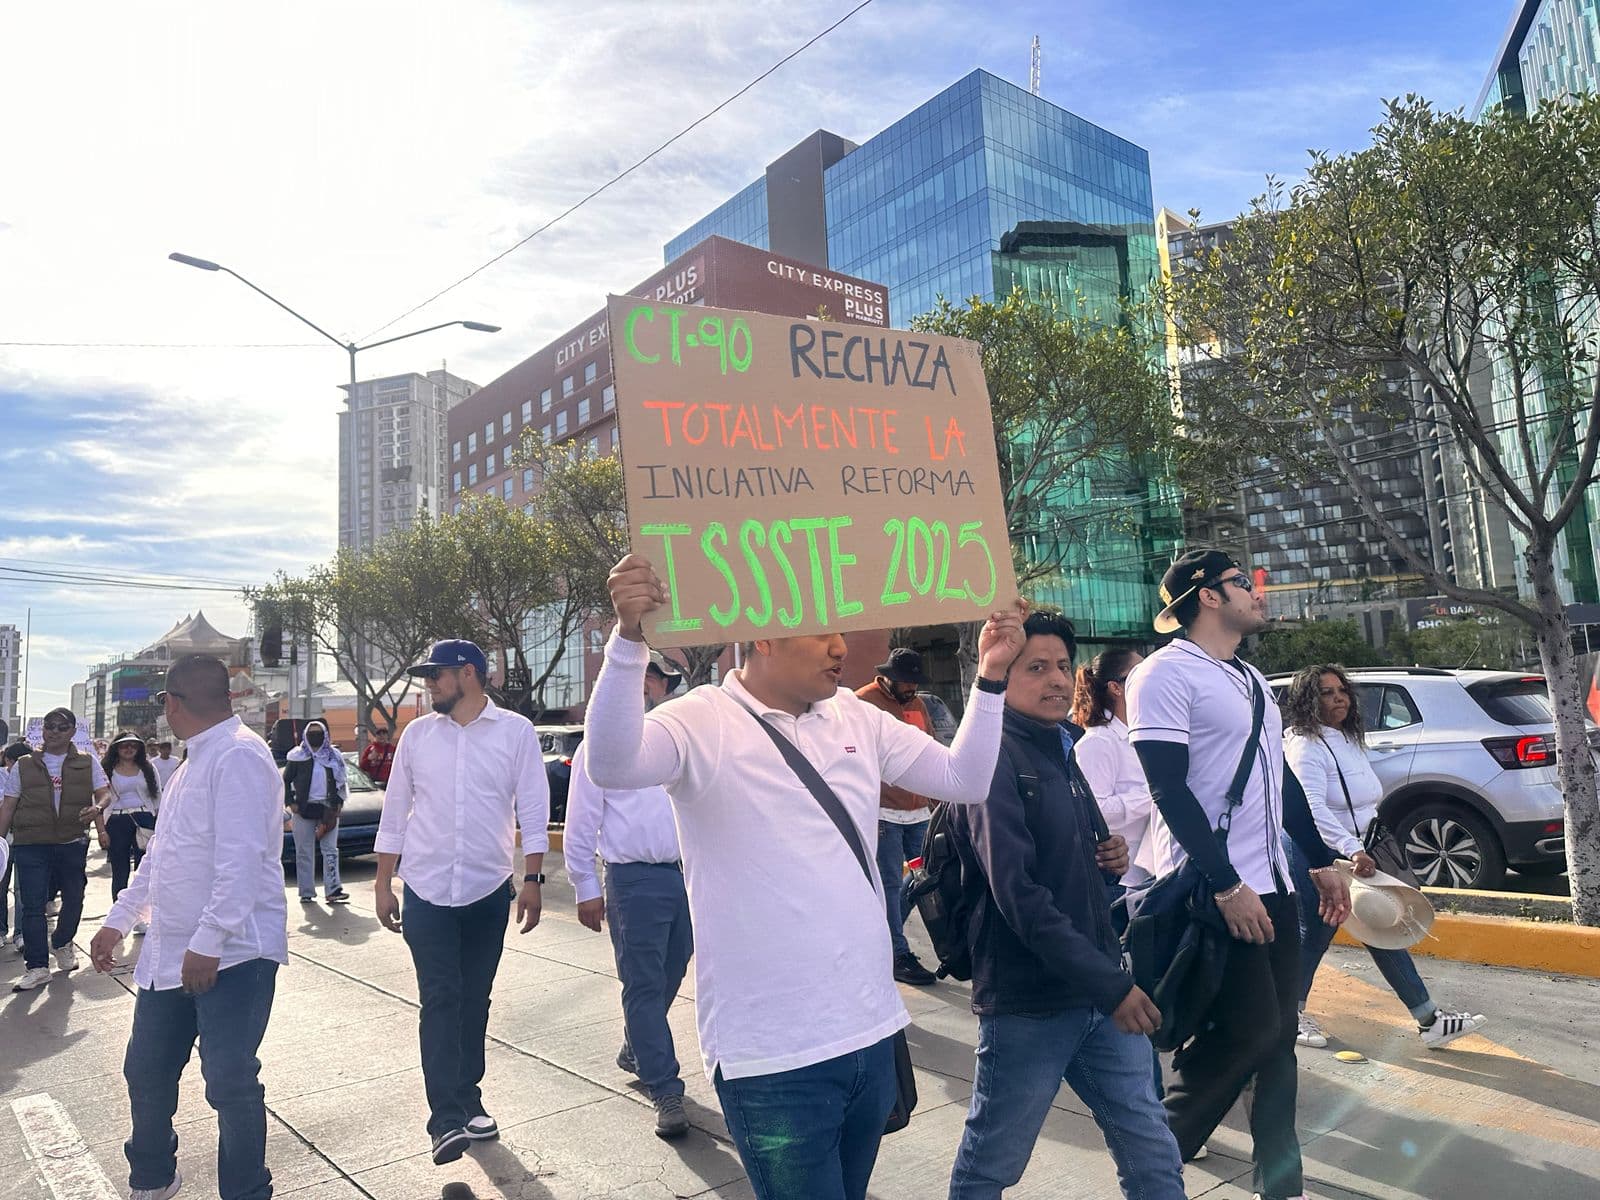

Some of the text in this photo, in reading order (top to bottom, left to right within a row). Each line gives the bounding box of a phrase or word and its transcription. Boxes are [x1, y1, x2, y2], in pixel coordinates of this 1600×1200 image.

[656, 265, 698, 302] PLUS
[767, 260, 883, 305] CITY EXPRESS
[844, 298, 884, 320] PLUS
[556, 336, 585, 366] CITY
[789, 323, 957, 396] RECHAZA
[643, 400, 966, 461] TOTALMENTE LA
[637, 464, 976, 499] INICIATIVA REFORMA
[639, 515, 997, 632] ISSSTE 2025
